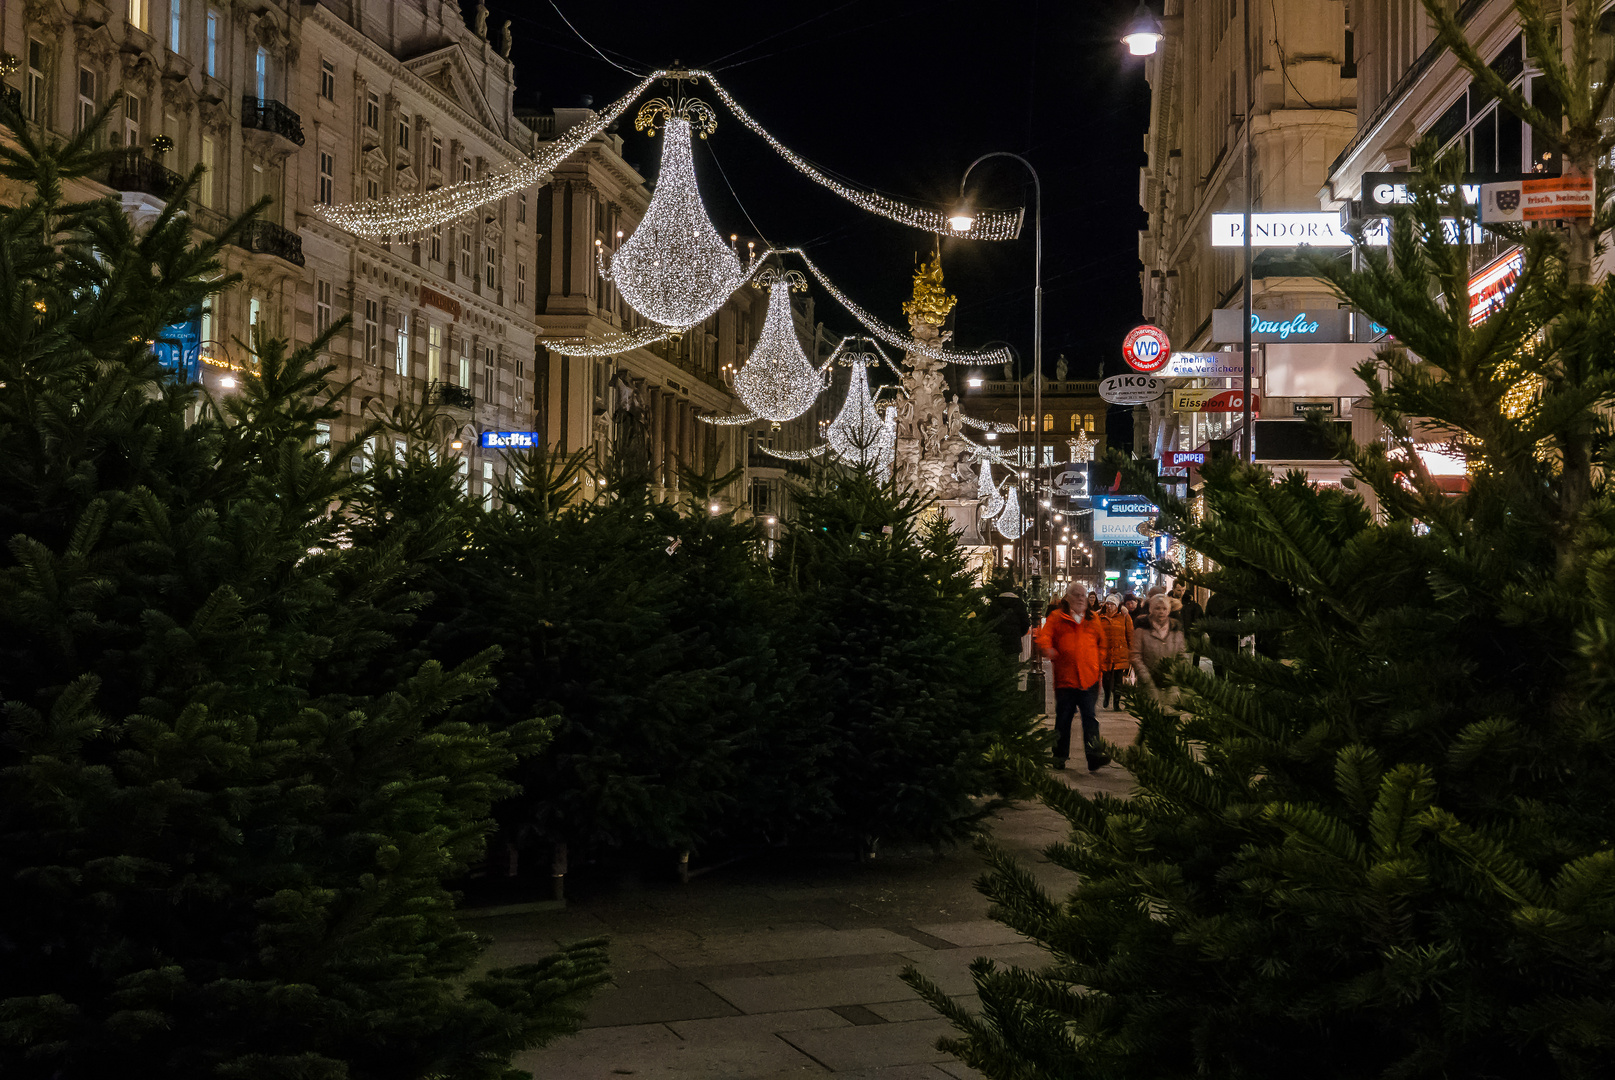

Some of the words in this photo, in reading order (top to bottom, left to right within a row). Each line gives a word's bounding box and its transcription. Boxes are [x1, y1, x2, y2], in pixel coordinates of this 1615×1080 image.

[1251, 312, 1319, 339] Douglas
[1135, 341, 1159, 356] VVD
[1195, 365, 1254, 374] Versicherug
[1106, 377, 1157, 391] ZIKOS
[1179, 398, 1225, 408] Eissalon
[488, 433, 532, 446] Berlitz
[1173, 453, 1205, 465] CAMPER
[1111, 503, 1152, 513] swatch
